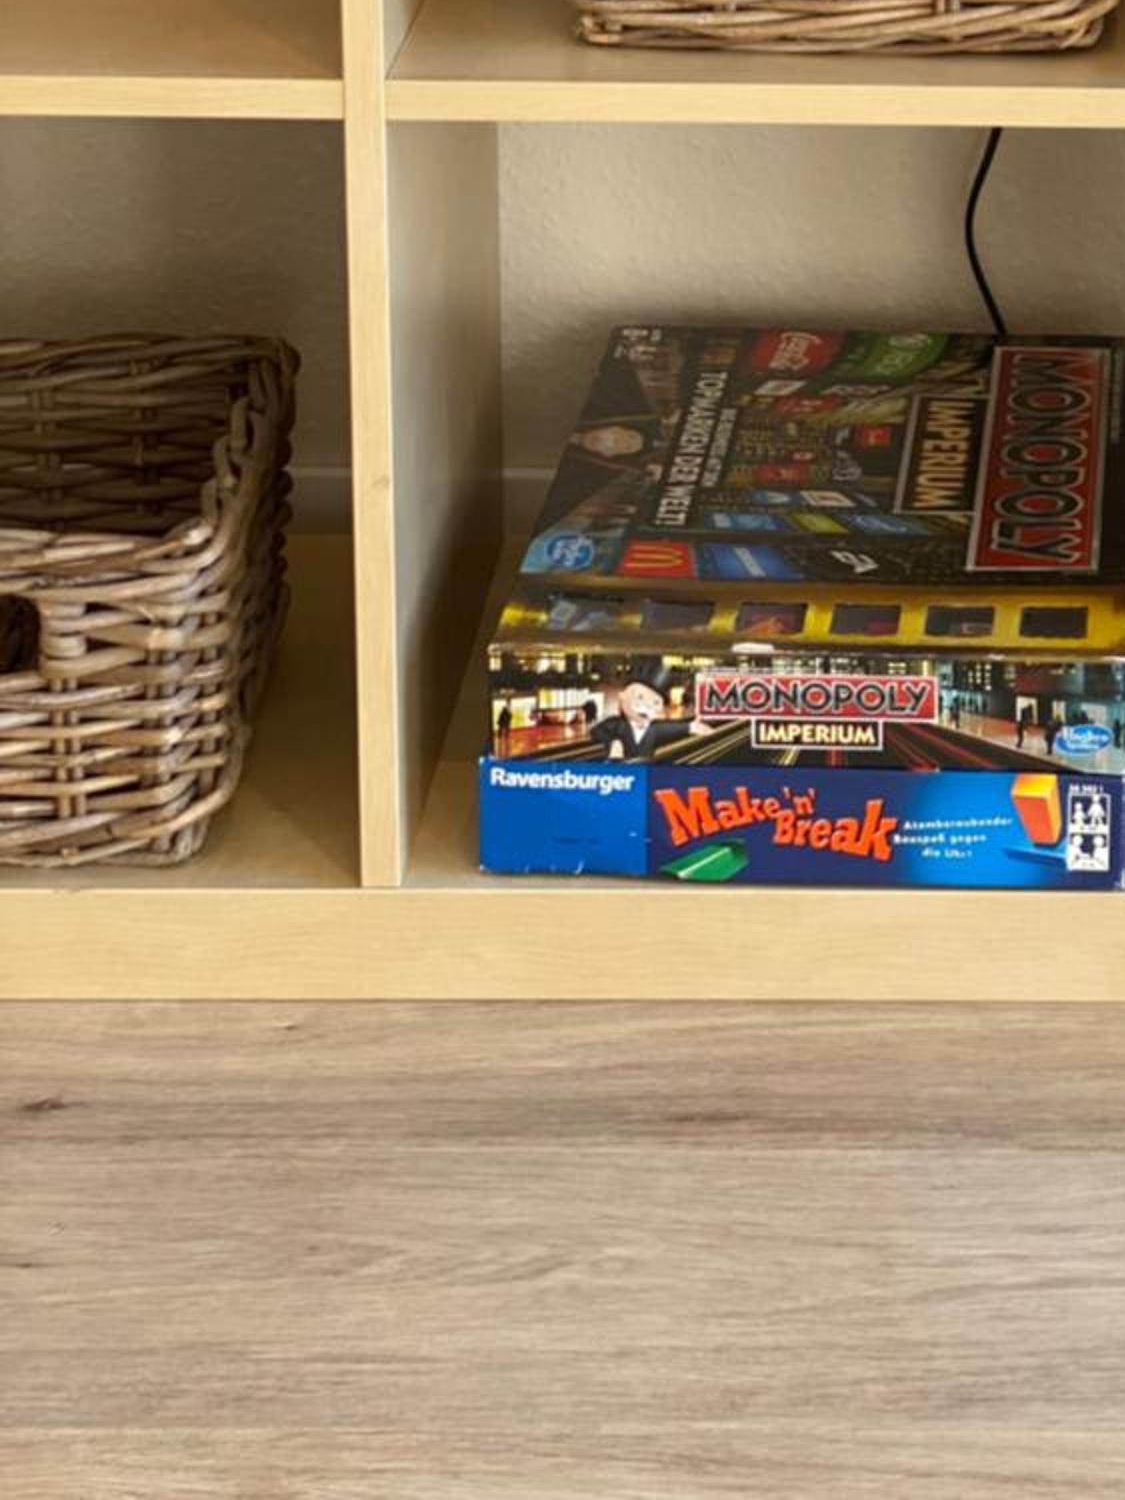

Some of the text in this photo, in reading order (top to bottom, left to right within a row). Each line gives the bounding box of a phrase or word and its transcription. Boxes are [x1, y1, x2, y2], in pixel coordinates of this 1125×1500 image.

[673, 371, 729, 454] TOPMARKEN
[664, 456, 702, 483] DER
[911, 401, 976, 508] IMPERIUM
[991, 353, 1090, 563] MONOPOLY
[702, 679, 928, 714] MONOPOLY
[758, 724, 877, 744] IMPERIUM
[490, 767, 635, 795] Ravensburger
[655, 786, 780, 848] Make
[773, 798, 900, 863] Break
